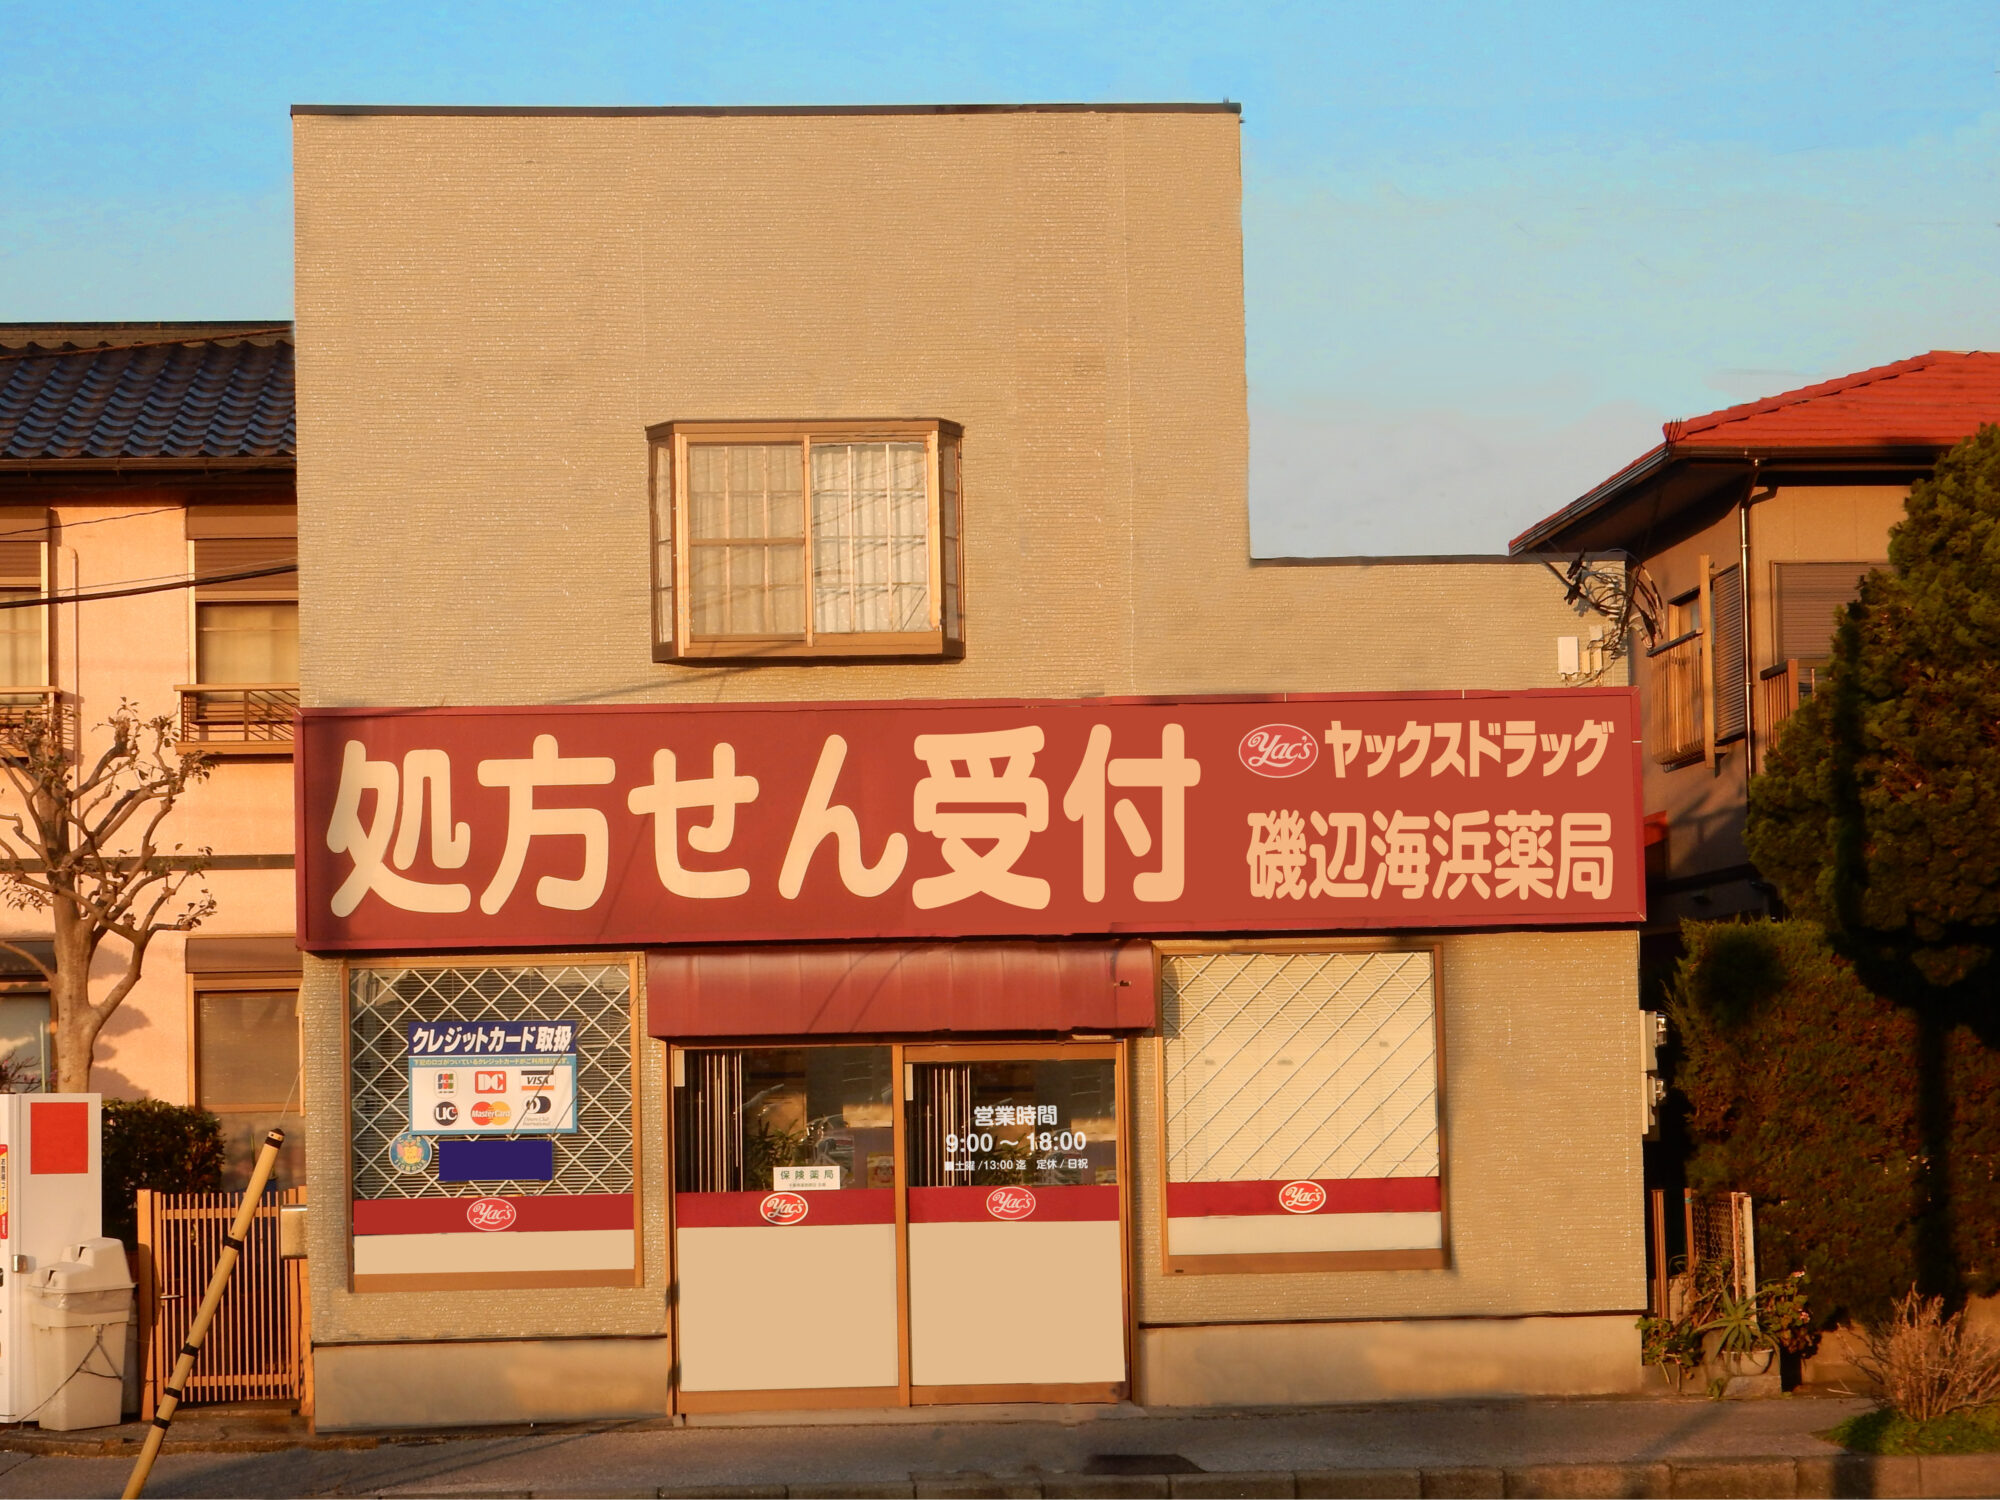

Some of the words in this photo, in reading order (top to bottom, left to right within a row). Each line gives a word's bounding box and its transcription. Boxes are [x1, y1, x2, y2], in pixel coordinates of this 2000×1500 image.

[1248, 731, 1313, 768] Yac's
[1324, 719, 1615, 779] ヤックスドラッグ
[326, 723, 1202, 918] 処方せん受付
[1246, 809, 1614, 900] 磯辺海浜薬局
[412, 1025, 573, 1054] クレジットカード取扱
[526, 1076, 549, 1085] VISA
[471, 1109, 512, 1118] MasterCard
[973, 1105, 1058, 1127] 営業時間
[780, 1169, 834, 1180] 保険薬局
[766, 1197, 804, 1218] Yac's
[992, 1190, 1032, 1214] Yac's
[1285, 1186, 1322, 1207] Yac's
[472, 1202, 514, 1225] Yac's
